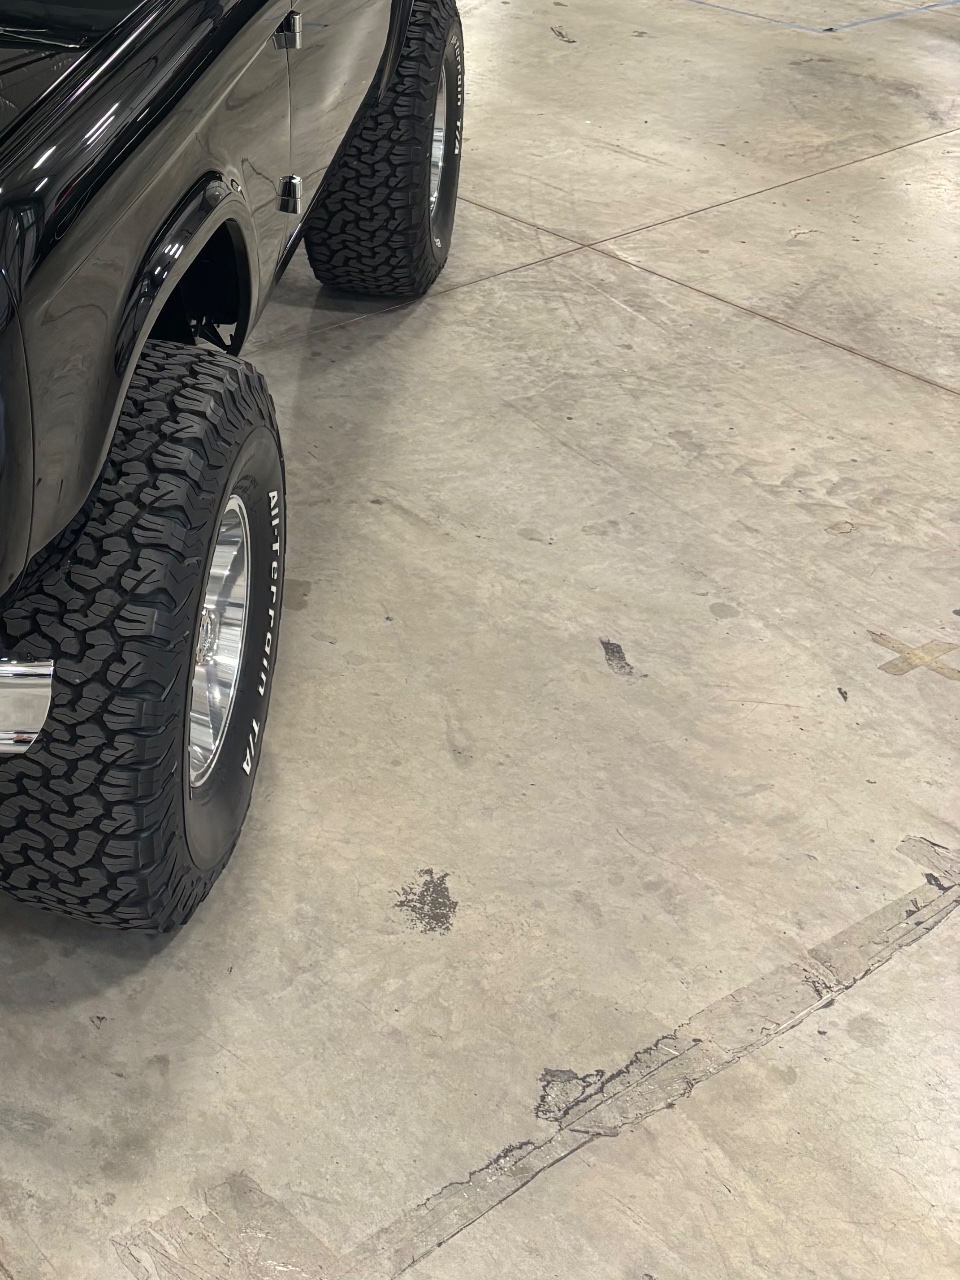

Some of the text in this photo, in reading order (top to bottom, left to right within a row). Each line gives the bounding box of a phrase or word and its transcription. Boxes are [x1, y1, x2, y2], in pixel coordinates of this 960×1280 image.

[454, 118, 462, 155] T/A
[242, 490, 281, 777] All-Terrain T/A
